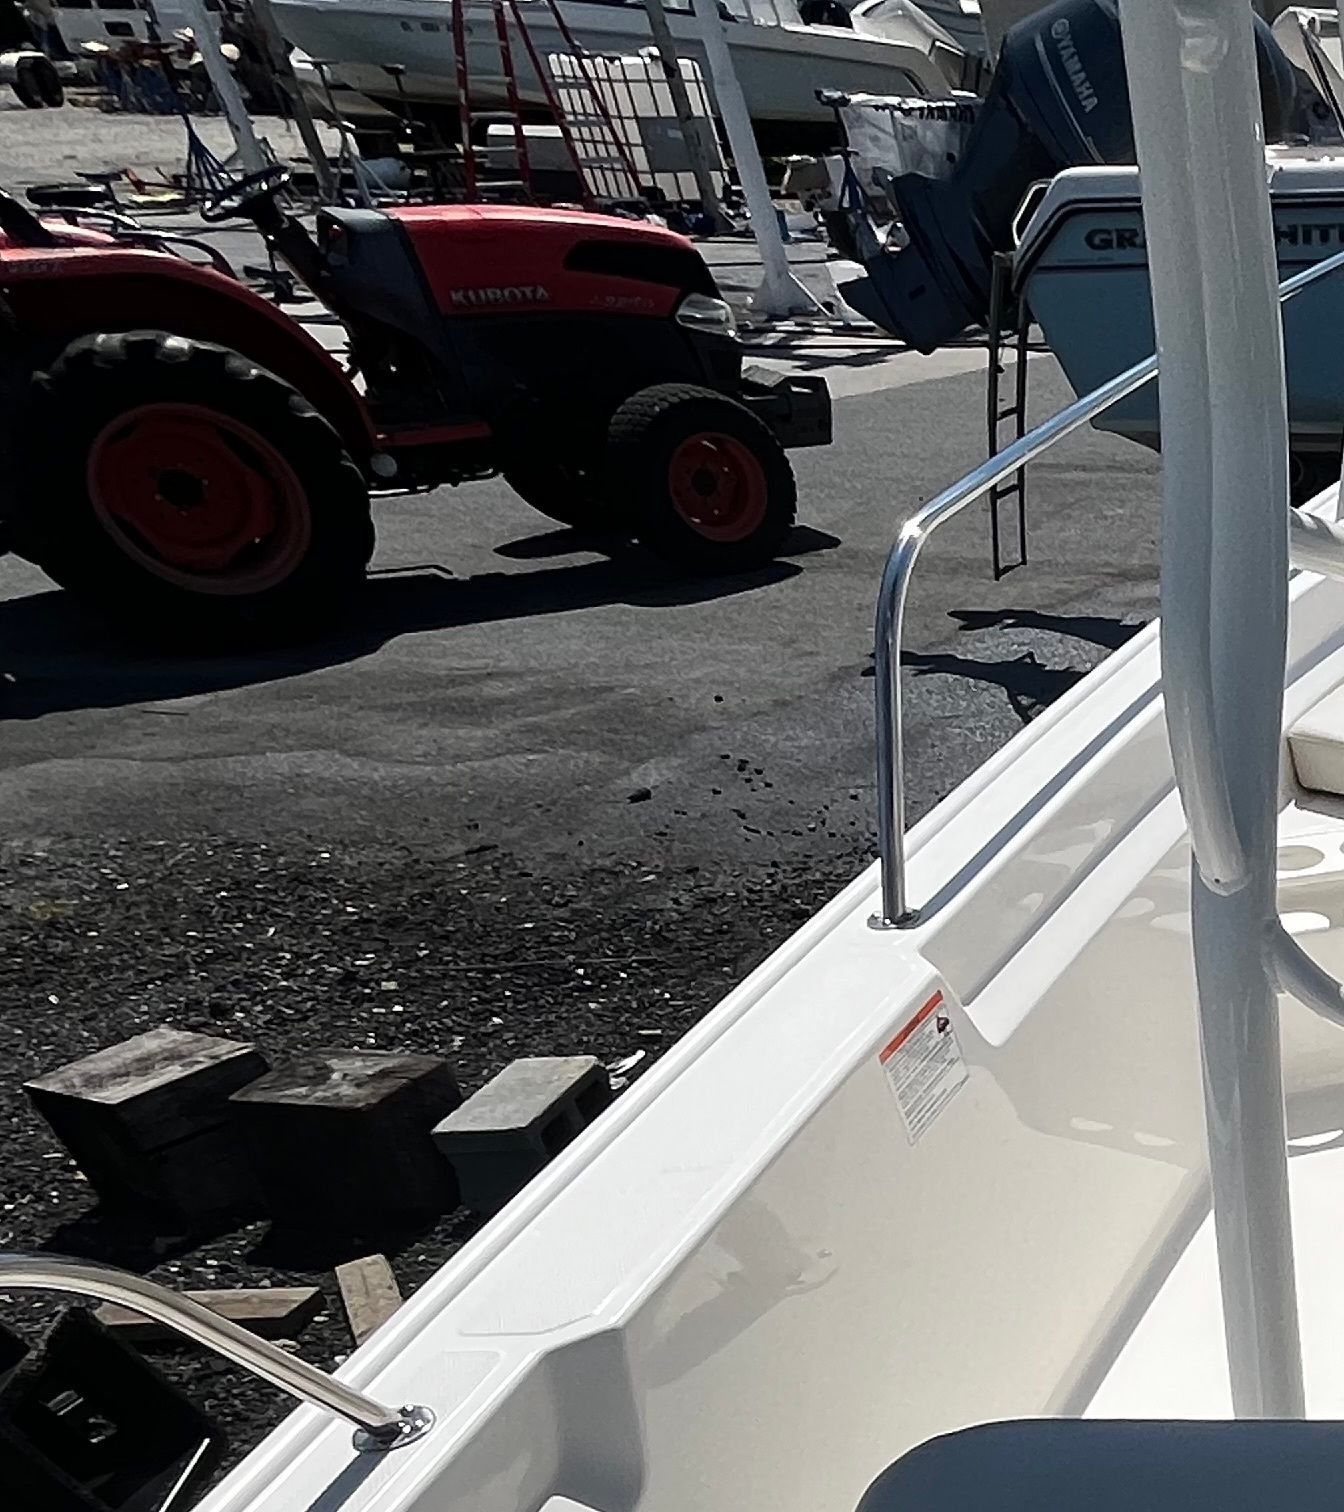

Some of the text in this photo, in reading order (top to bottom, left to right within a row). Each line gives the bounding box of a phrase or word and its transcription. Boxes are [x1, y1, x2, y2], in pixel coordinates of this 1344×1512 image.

[1056, 33, 1099, 114] YAMAHA
[1084, 228, 1145, 251] GR
[449, 285, 552, 307] KUBOTA
